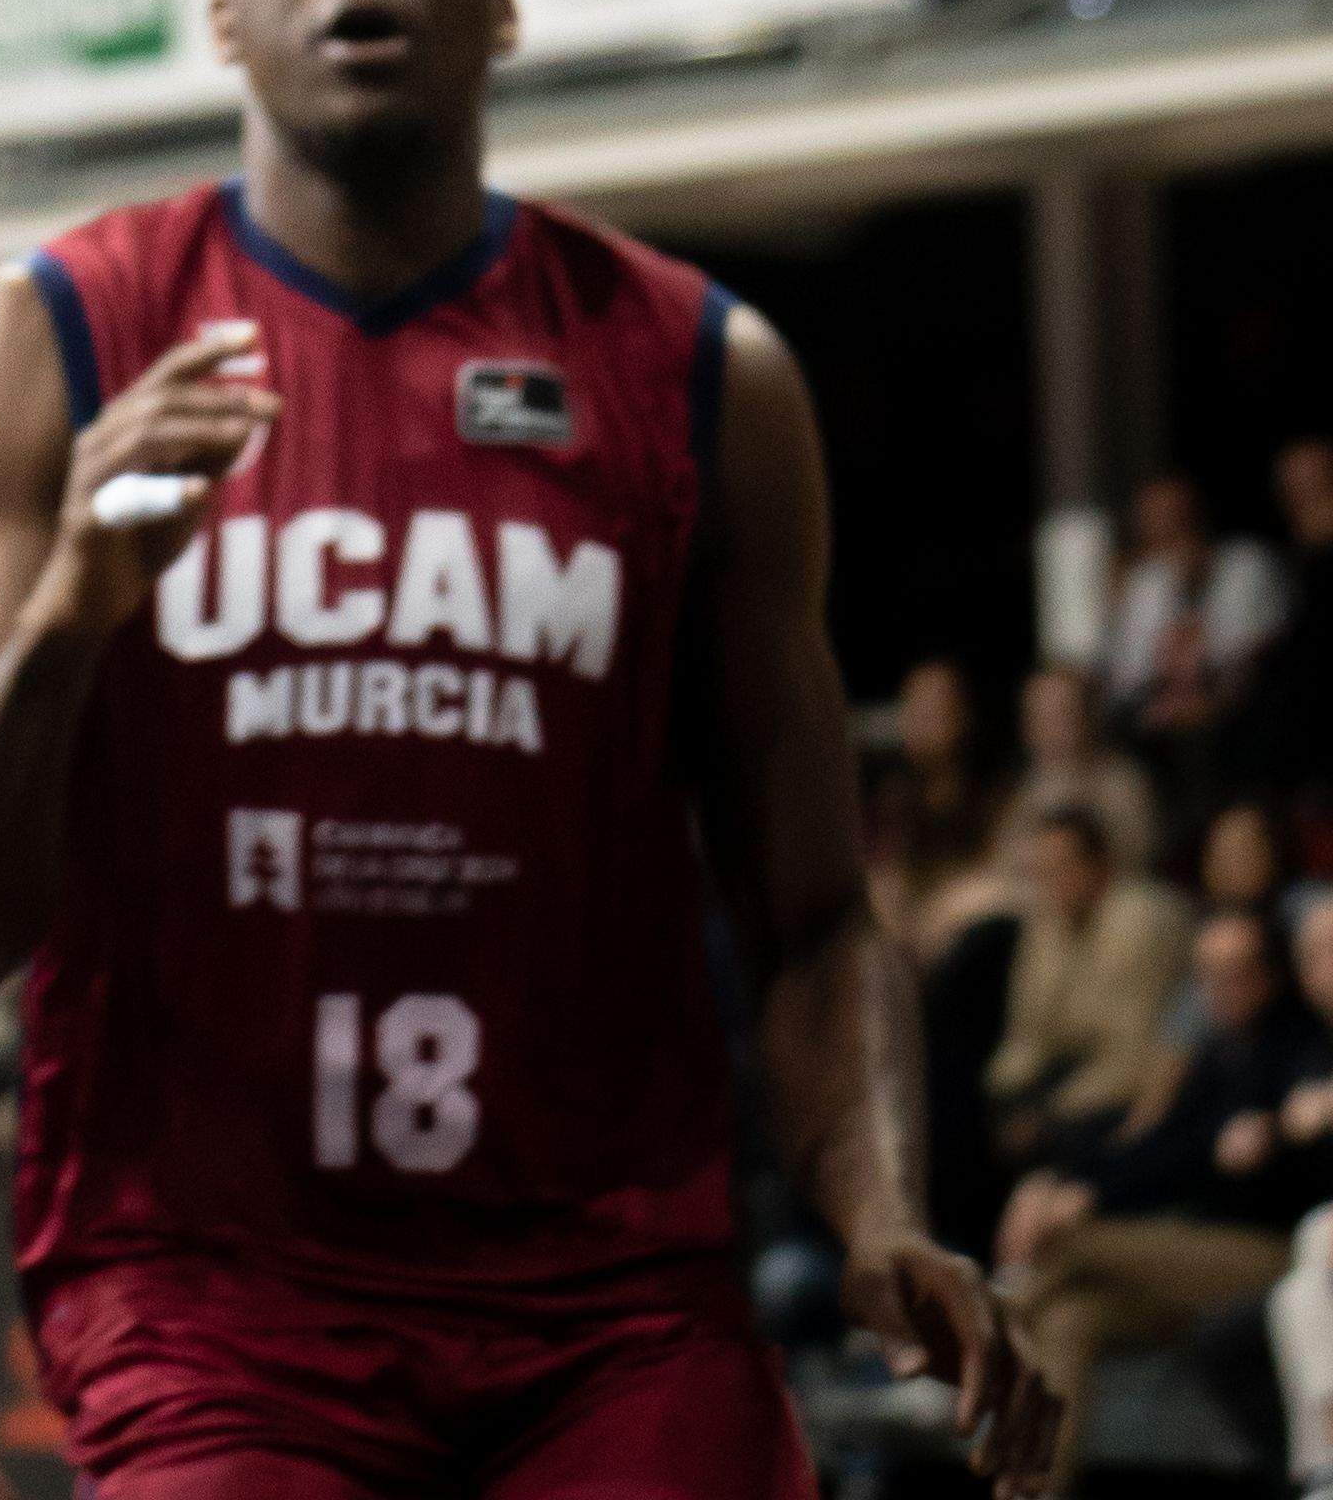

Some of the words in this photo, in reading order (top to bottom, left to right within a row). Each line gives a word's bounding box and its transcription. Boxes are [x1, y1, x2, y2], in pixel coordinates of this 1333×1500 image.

[155, 506, 622, 682] UCAM
[224, 660, 544, 757] MURCIA
[312, 990, 482, 1173] 18
